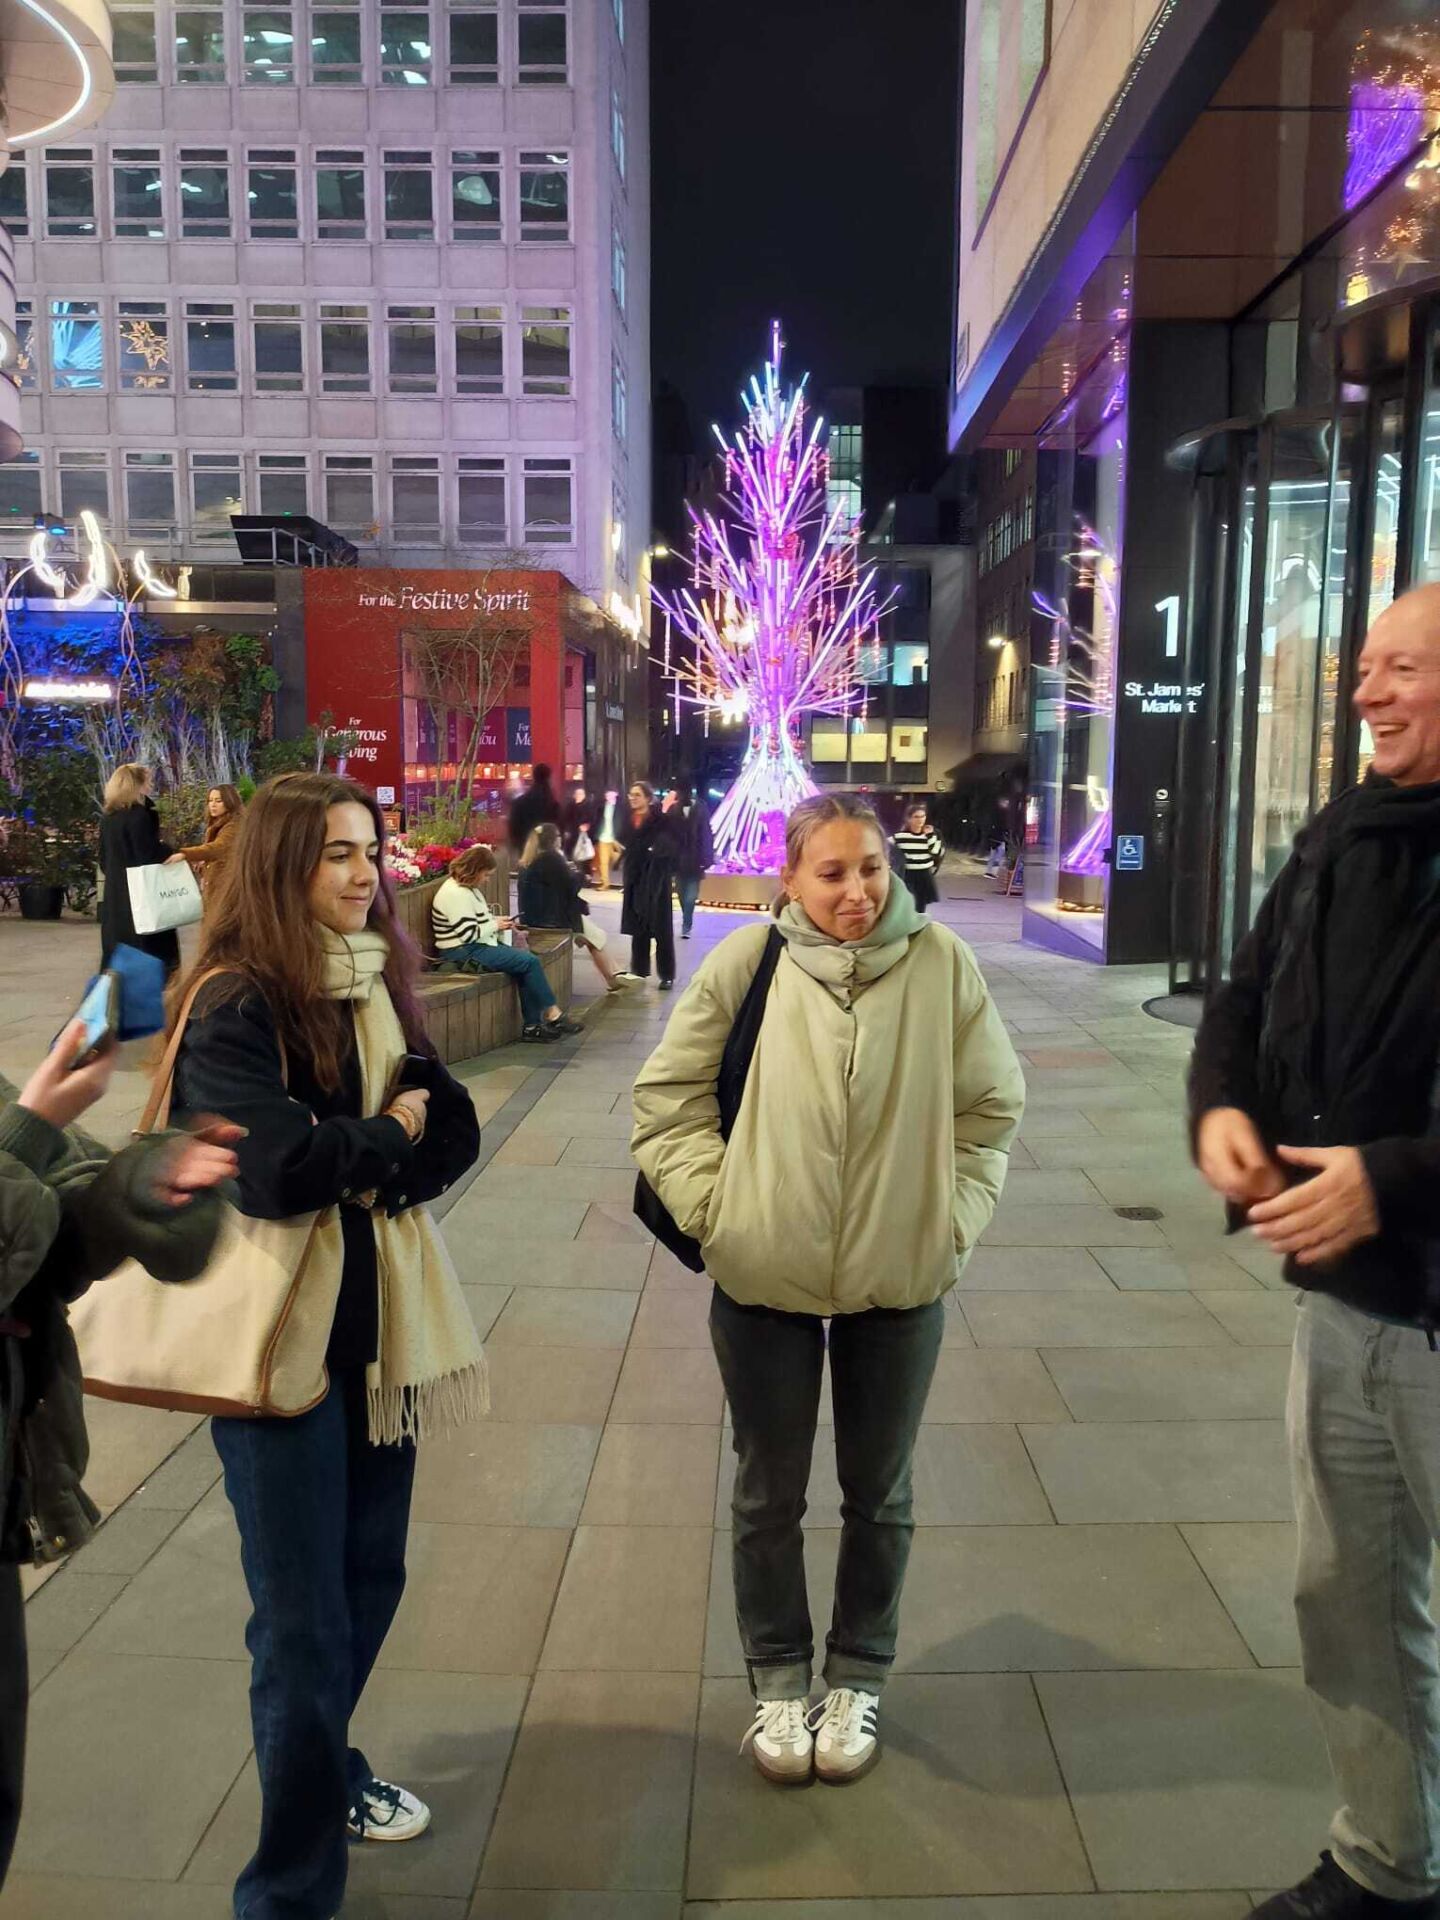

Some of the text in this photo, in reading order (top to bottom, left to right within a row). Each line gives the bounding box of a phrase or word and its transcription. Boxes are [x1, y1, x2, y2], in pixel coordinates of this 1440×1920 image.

[359, 586, 530, 615] For the Festive Spirit
[1155, 596, 1180, 657] 1
[349, 716, 362, 726] For
[518, 722, 531, 731] For
